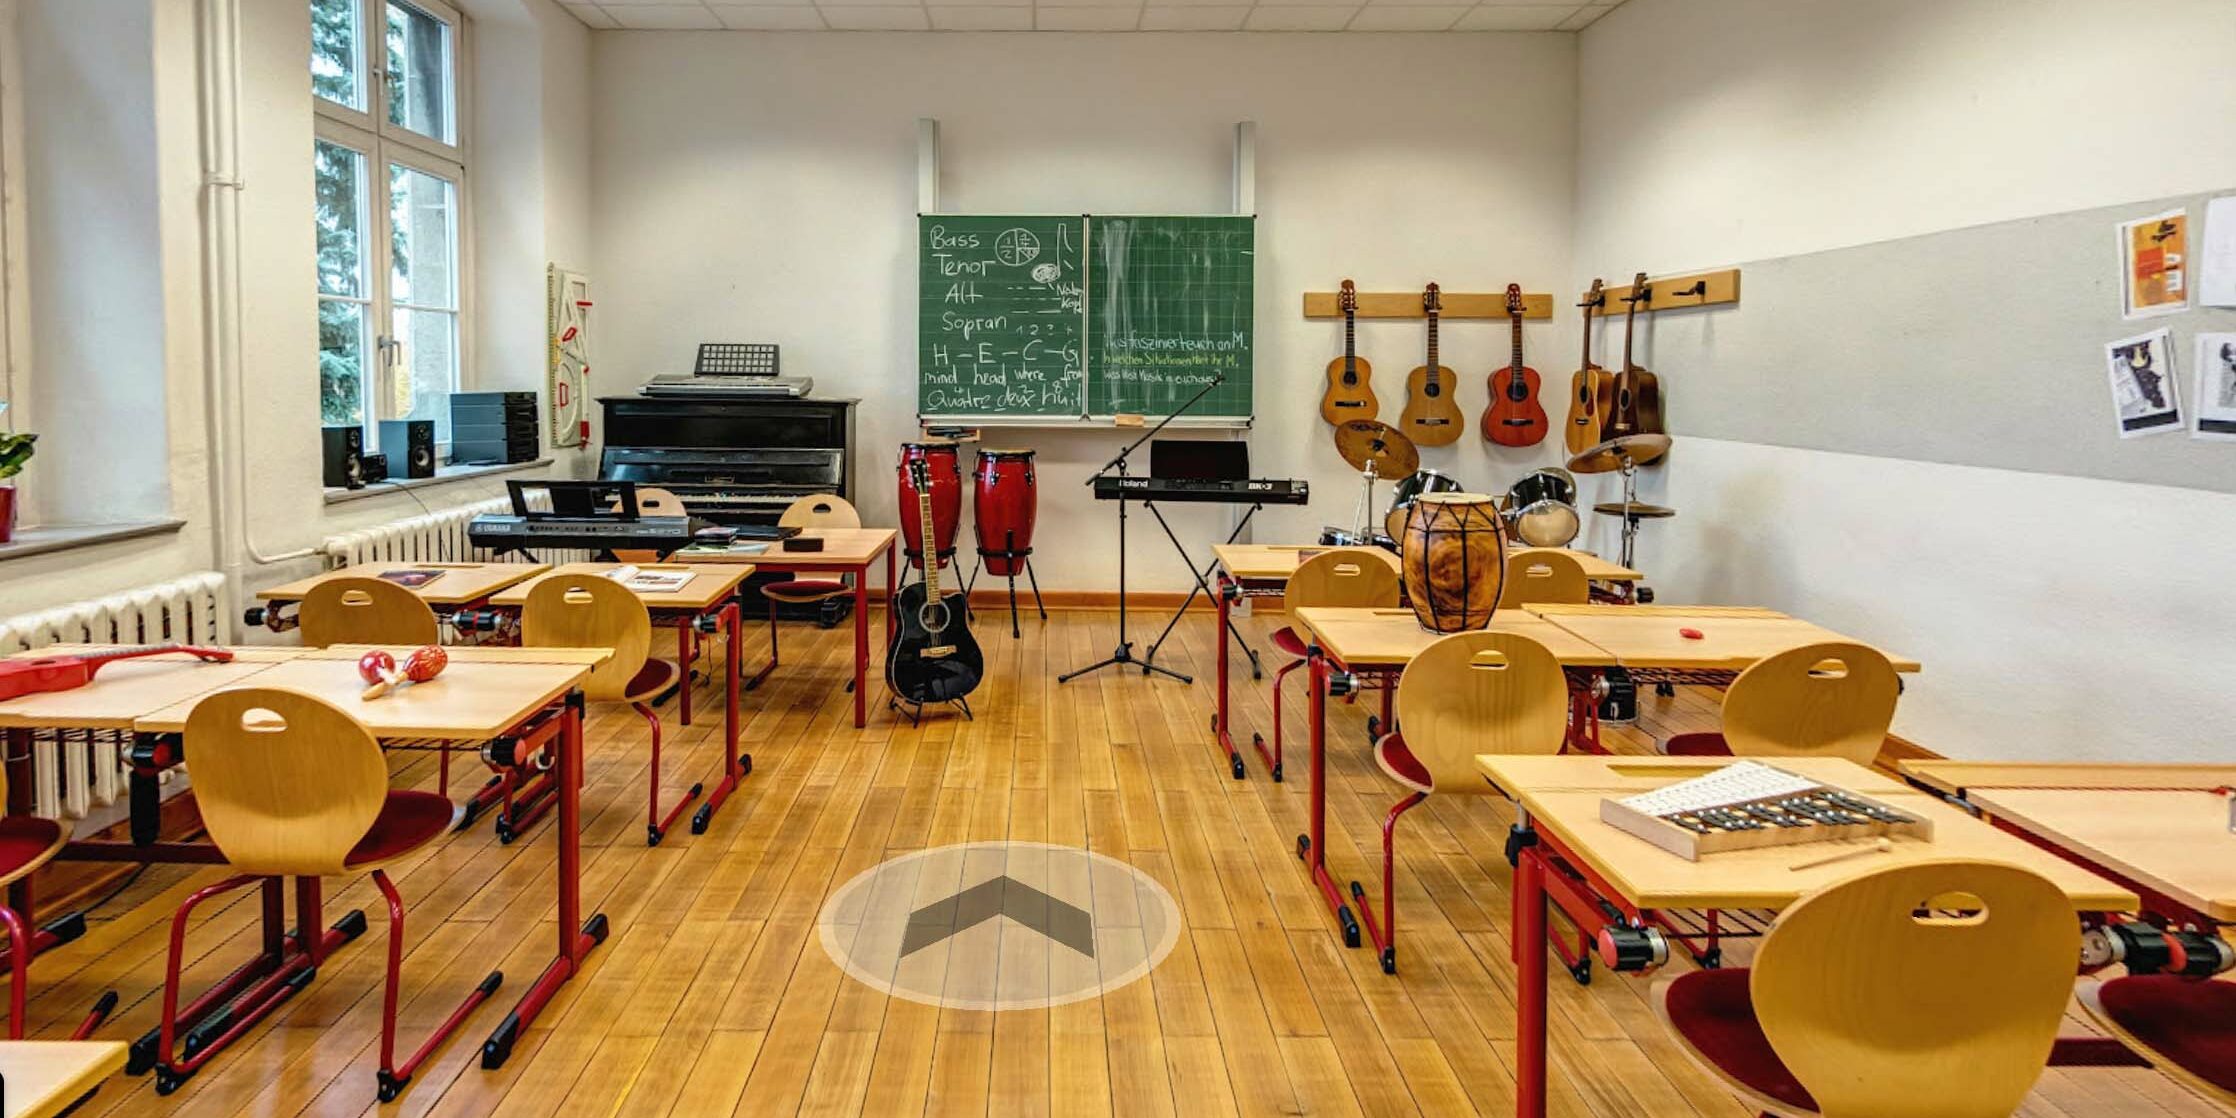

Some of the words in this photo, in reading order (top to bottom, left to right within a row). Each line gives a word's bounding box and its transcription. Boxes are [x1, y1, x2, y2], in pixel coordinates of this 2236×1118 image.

[930, 225, 980, 250] Bass
[931, 254, 996, 277] Tenor
[945, 281, 983, 304] Alt
[942, 311, 1007, 340] Sopran
[1029, 324, 1039, 336] 2
[933, 343, 949, 366] H
[978, 342, 997, 363] E
[1022, 339, 1043, 361] C
[924, 364, 958, 385] mind
[973, 363, 1007, 387] head
[1013, 362, 1047, 383] where
